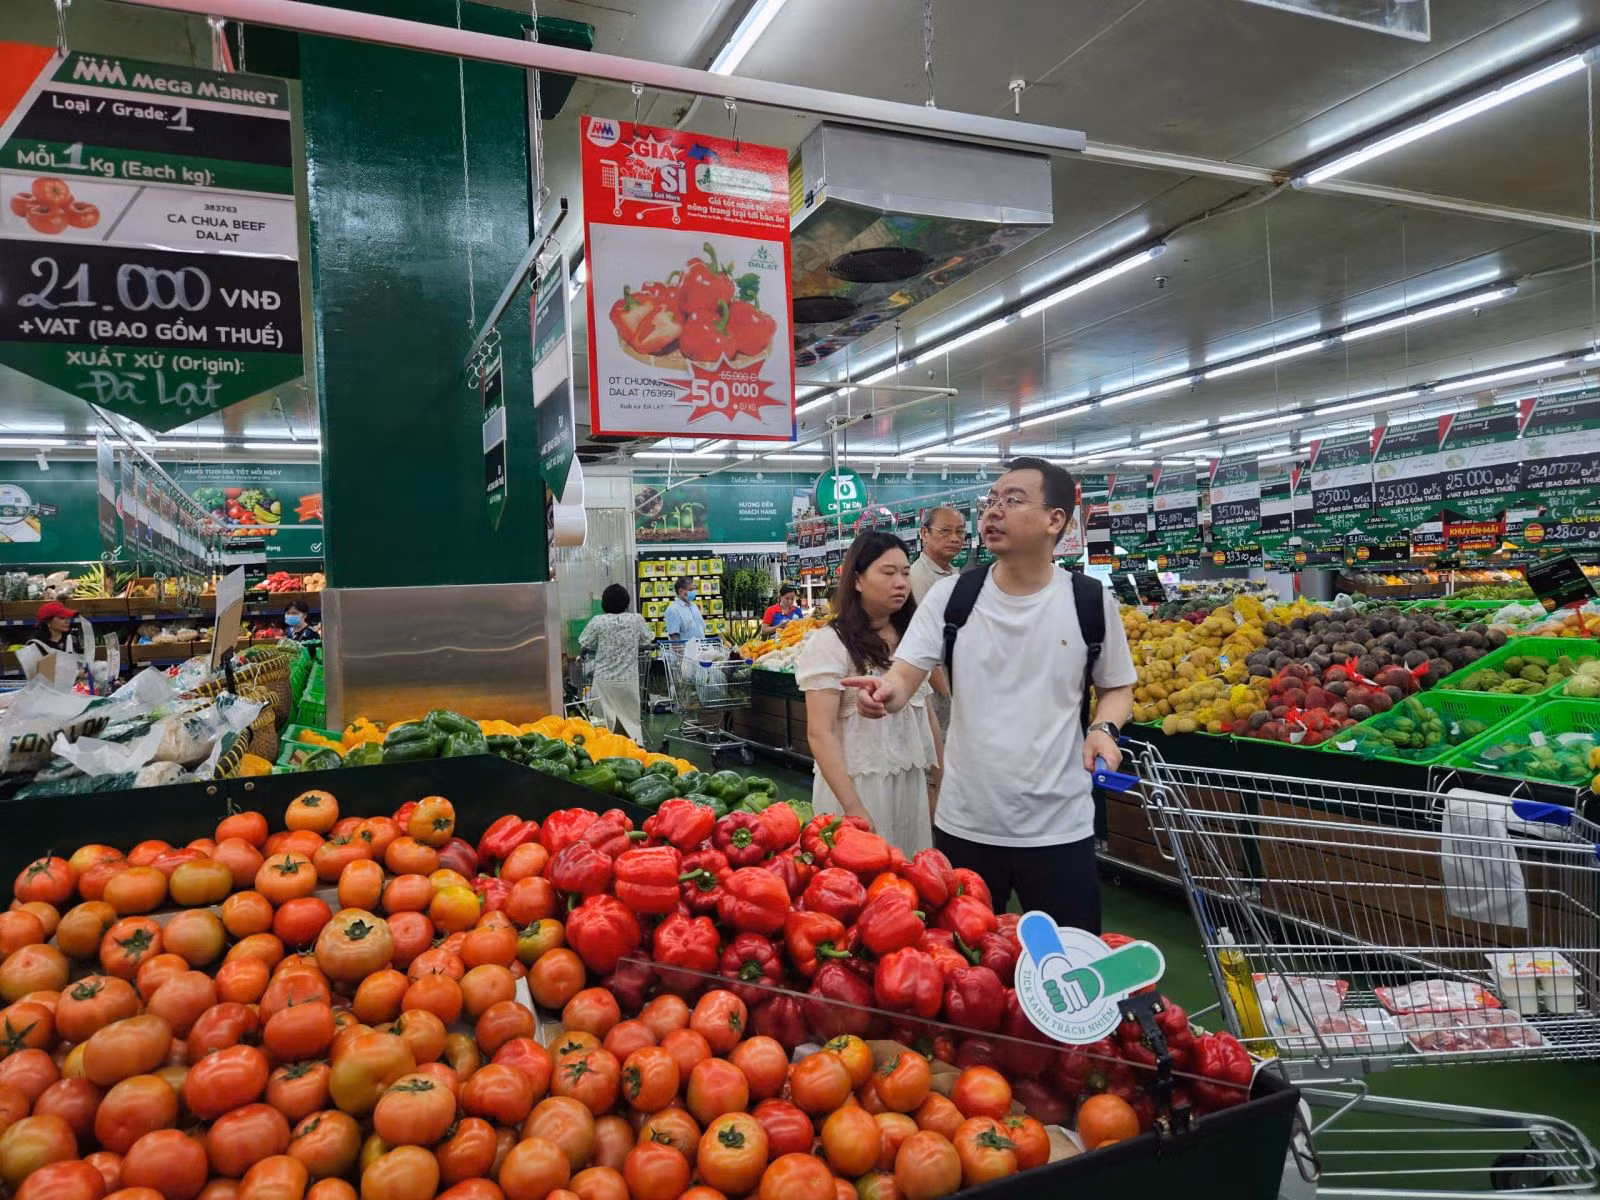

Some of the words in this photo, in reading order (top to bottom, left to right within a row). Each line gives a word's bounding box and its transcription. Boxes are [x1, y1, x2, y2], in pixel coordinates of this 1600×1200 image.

[52, 95, 90, 117] Loại
[96, 101, 106, 113] /
[112, 103, 168, 121] Grade:
[166, 107, 194, 132] 1
[52, 142, 88, 169] 1
[89, 157, 115, 177] Kg
[121, 160, 176, 180] (Each
[182, 163, 216, 185] kg):
[167, 213, 188, 225] CA
[191, 215, 230, 229] CHUA
[232, 219, 266, 232] BEEF
[196, 230, 240, 243] DALAT
[748, 261, 778, 270] DALAT
[219, 288, 281, 311] VNĐ
[19, 317, 80, 336] +VAT
[89, 319, 147, 340] (BAO
[155, 316, 208, 342] GỒM
[215, 321, 284, 349] THUẾ)
[66, 346, 126, 369] XUẤT
[134, 350, 165, 369] XỨ
[172, 355, 245, 375] (Origin):
[155, 369, 222, 416] Lạt
[608, 376, 621, 386] OT
[609, 387, 639, 397] DALAT
[642, 388, 676, 398] (76399)
[691, 378, 729, 409] 50
[732, 382, 758, 398] 000
[1023, 969, 1032, 993] TICK
[1027, 996, 1053, 1024] XANH
[1088, 1008, 1117, 1033] NHIỆM
[1052, 1020, 1086, 1035] TRÁCH
